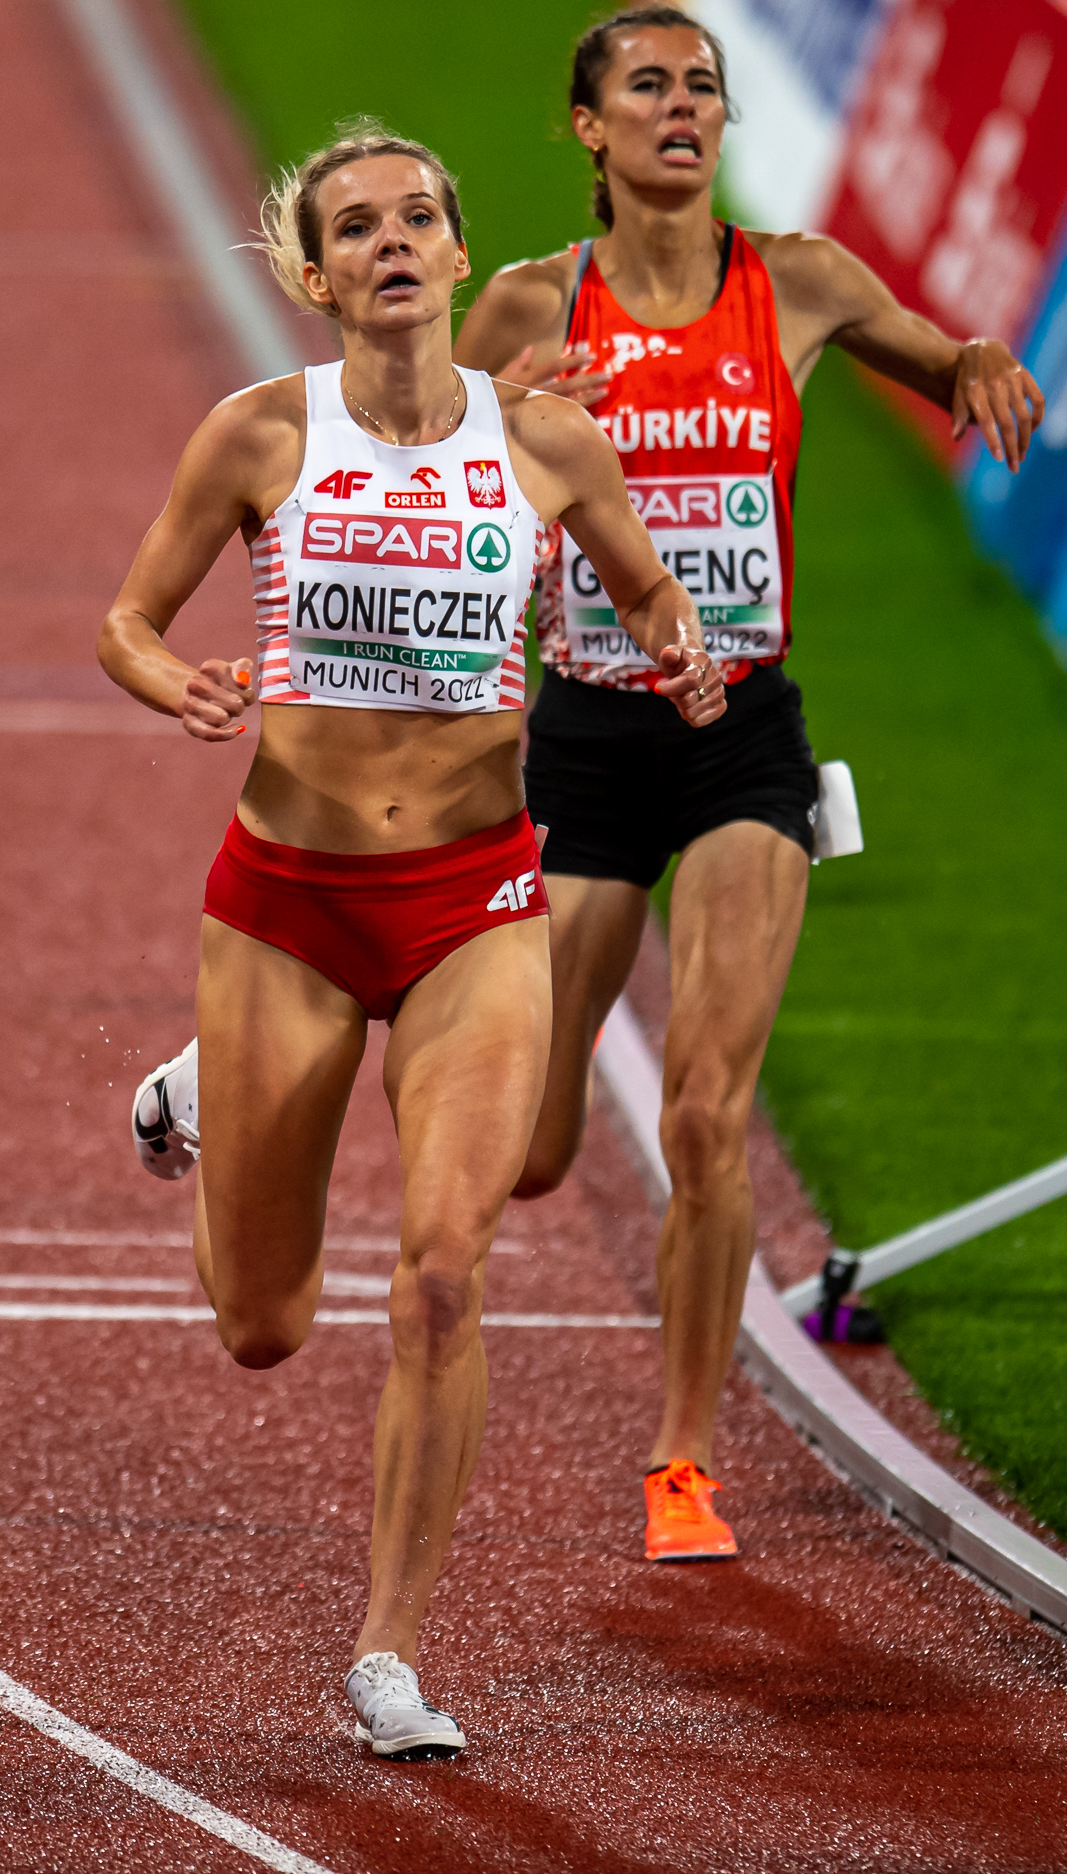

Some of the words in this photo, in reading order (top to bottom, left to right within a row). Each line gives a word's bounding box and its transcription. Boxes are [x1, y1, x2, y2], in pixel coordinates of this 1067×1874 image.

[314, 470, 373, 499] 4F
[387, 493, 442, 507] ORLEN
[306, 519, 458, 562] SPAR
[571, 547, 771, 606] GENÇ
[296, 580, 508, 643] KONIECZEK
[354, 643, 394, 661] RUN
[303, 660, 420, 697] MUNICH
[486, 870, 536, 911] 4F
